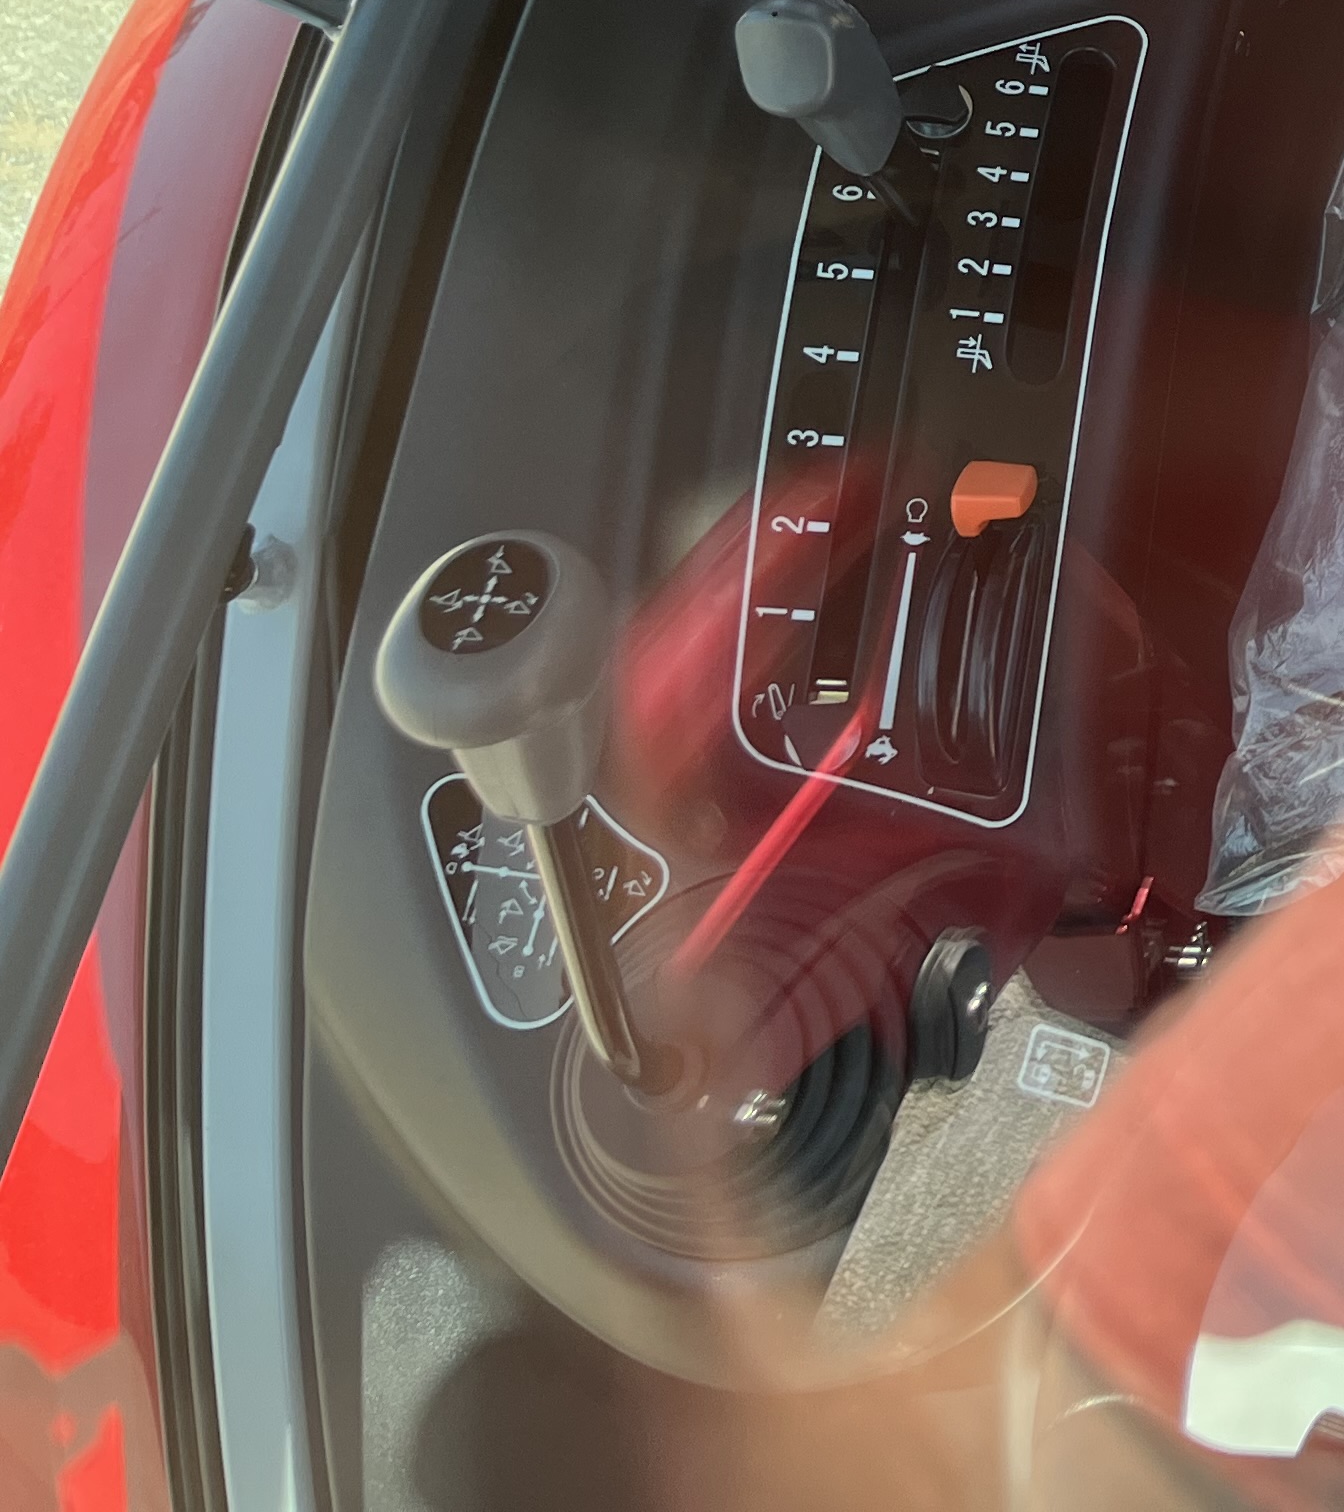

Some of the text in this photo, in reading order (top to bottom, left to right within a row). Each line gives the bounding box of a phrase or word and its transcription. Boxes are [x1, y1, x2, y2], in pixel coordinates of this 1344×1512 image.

[994, 79, 1026, 96] 6
[985, 120, 1017, 138] 5
[976, 165, 1008, 183] 4
[832, 184, 864, 202] 6
[967, 210, 999, 228] 3
[816, 261, 849, 281] 5
[957, 257, 990, 277] 2
[949, 307, 981, 320] 1
[803, 344, 835, 364] 4
[787, 428, 820, 449] 3
[771, 514, 806, 535] 2
[755, 606, 788, 618] 1
